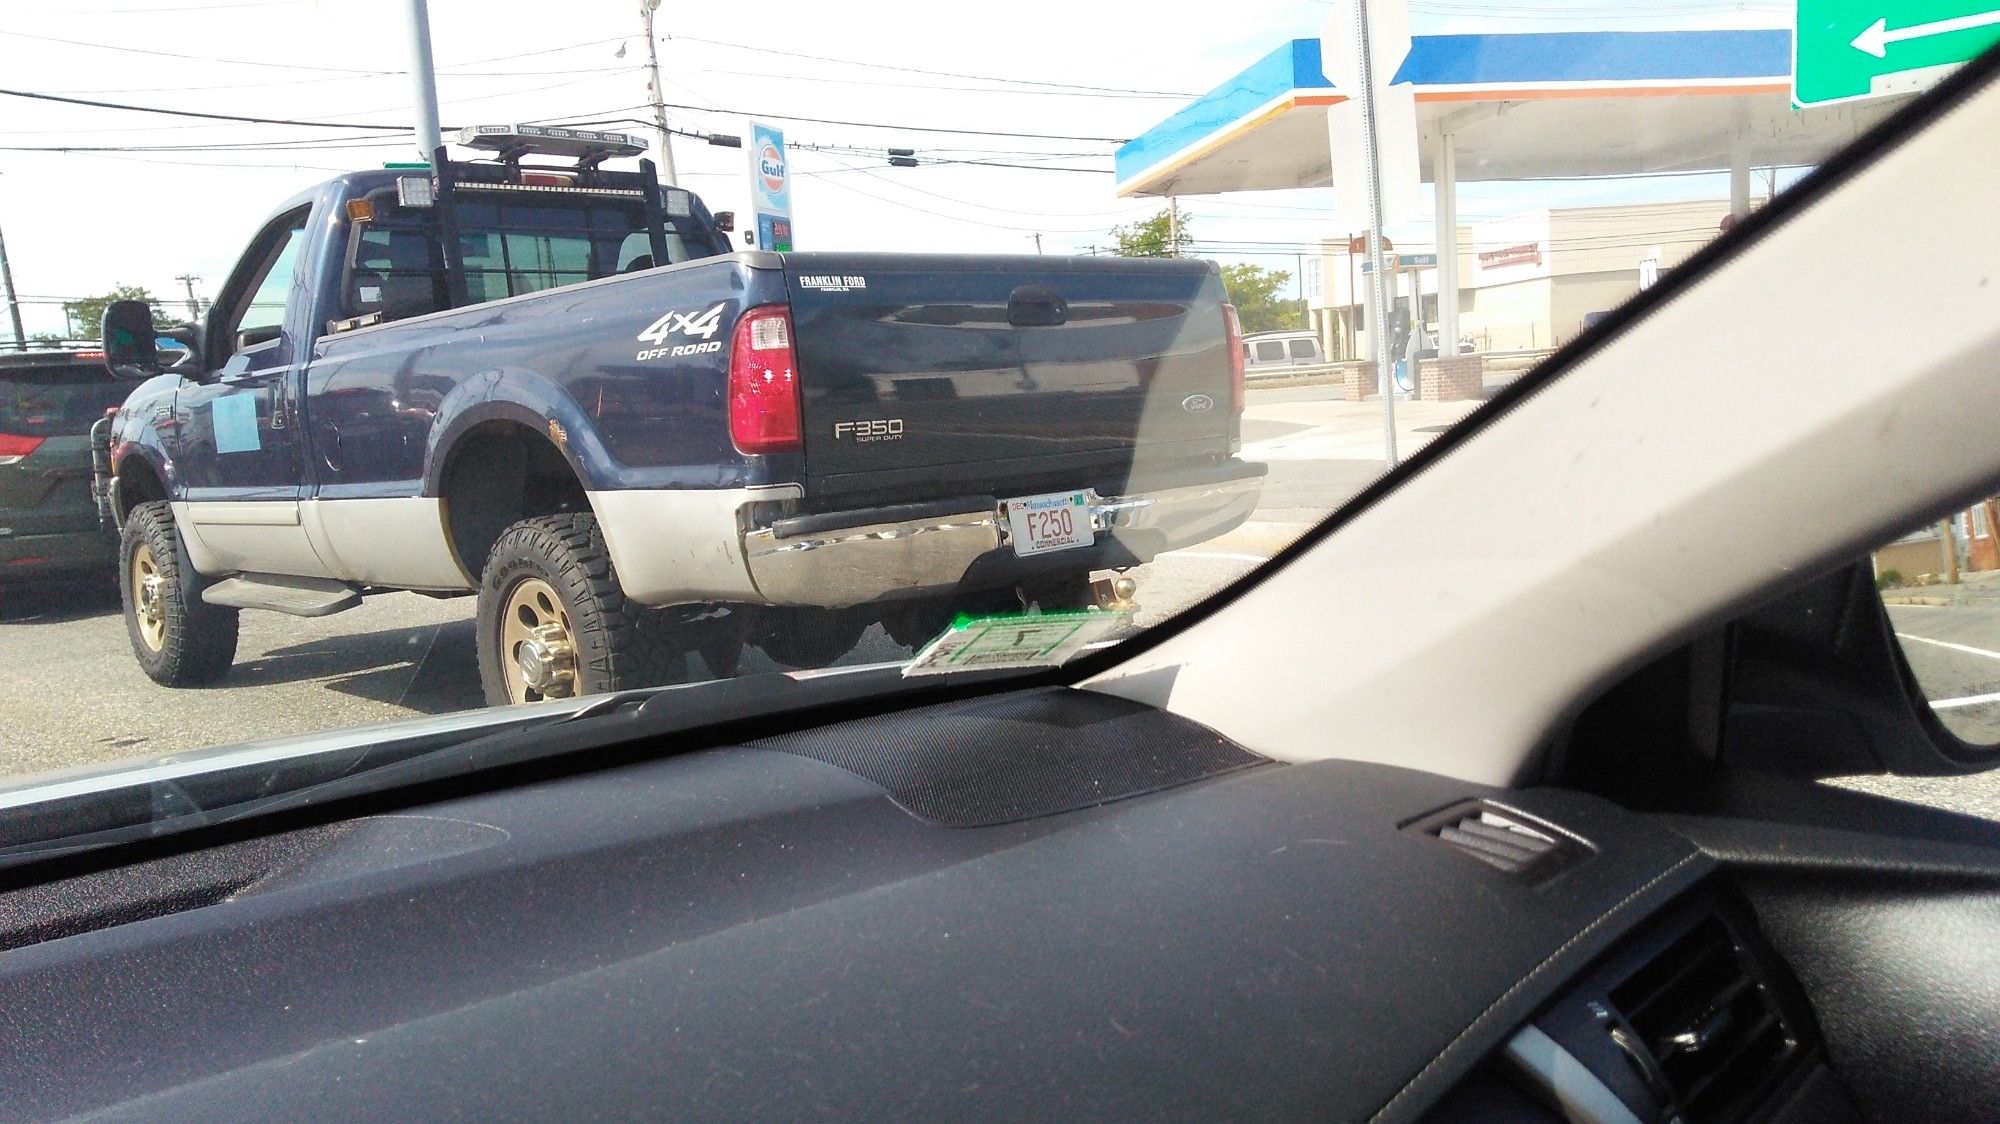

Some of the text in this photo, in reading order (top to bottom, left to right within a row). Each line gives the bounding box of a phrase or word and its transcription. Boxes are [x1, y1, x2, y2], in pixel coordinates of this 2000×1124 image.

[761, 160, 785, 178] Gulf
[799, 275, 866, 286] FRANKLIN FORD
[636, 341, 722, 361] OFF ROAD
[1026, 508, 1073, 541] F250
[1036, 537, 1075, 549] COMMERCIAL
